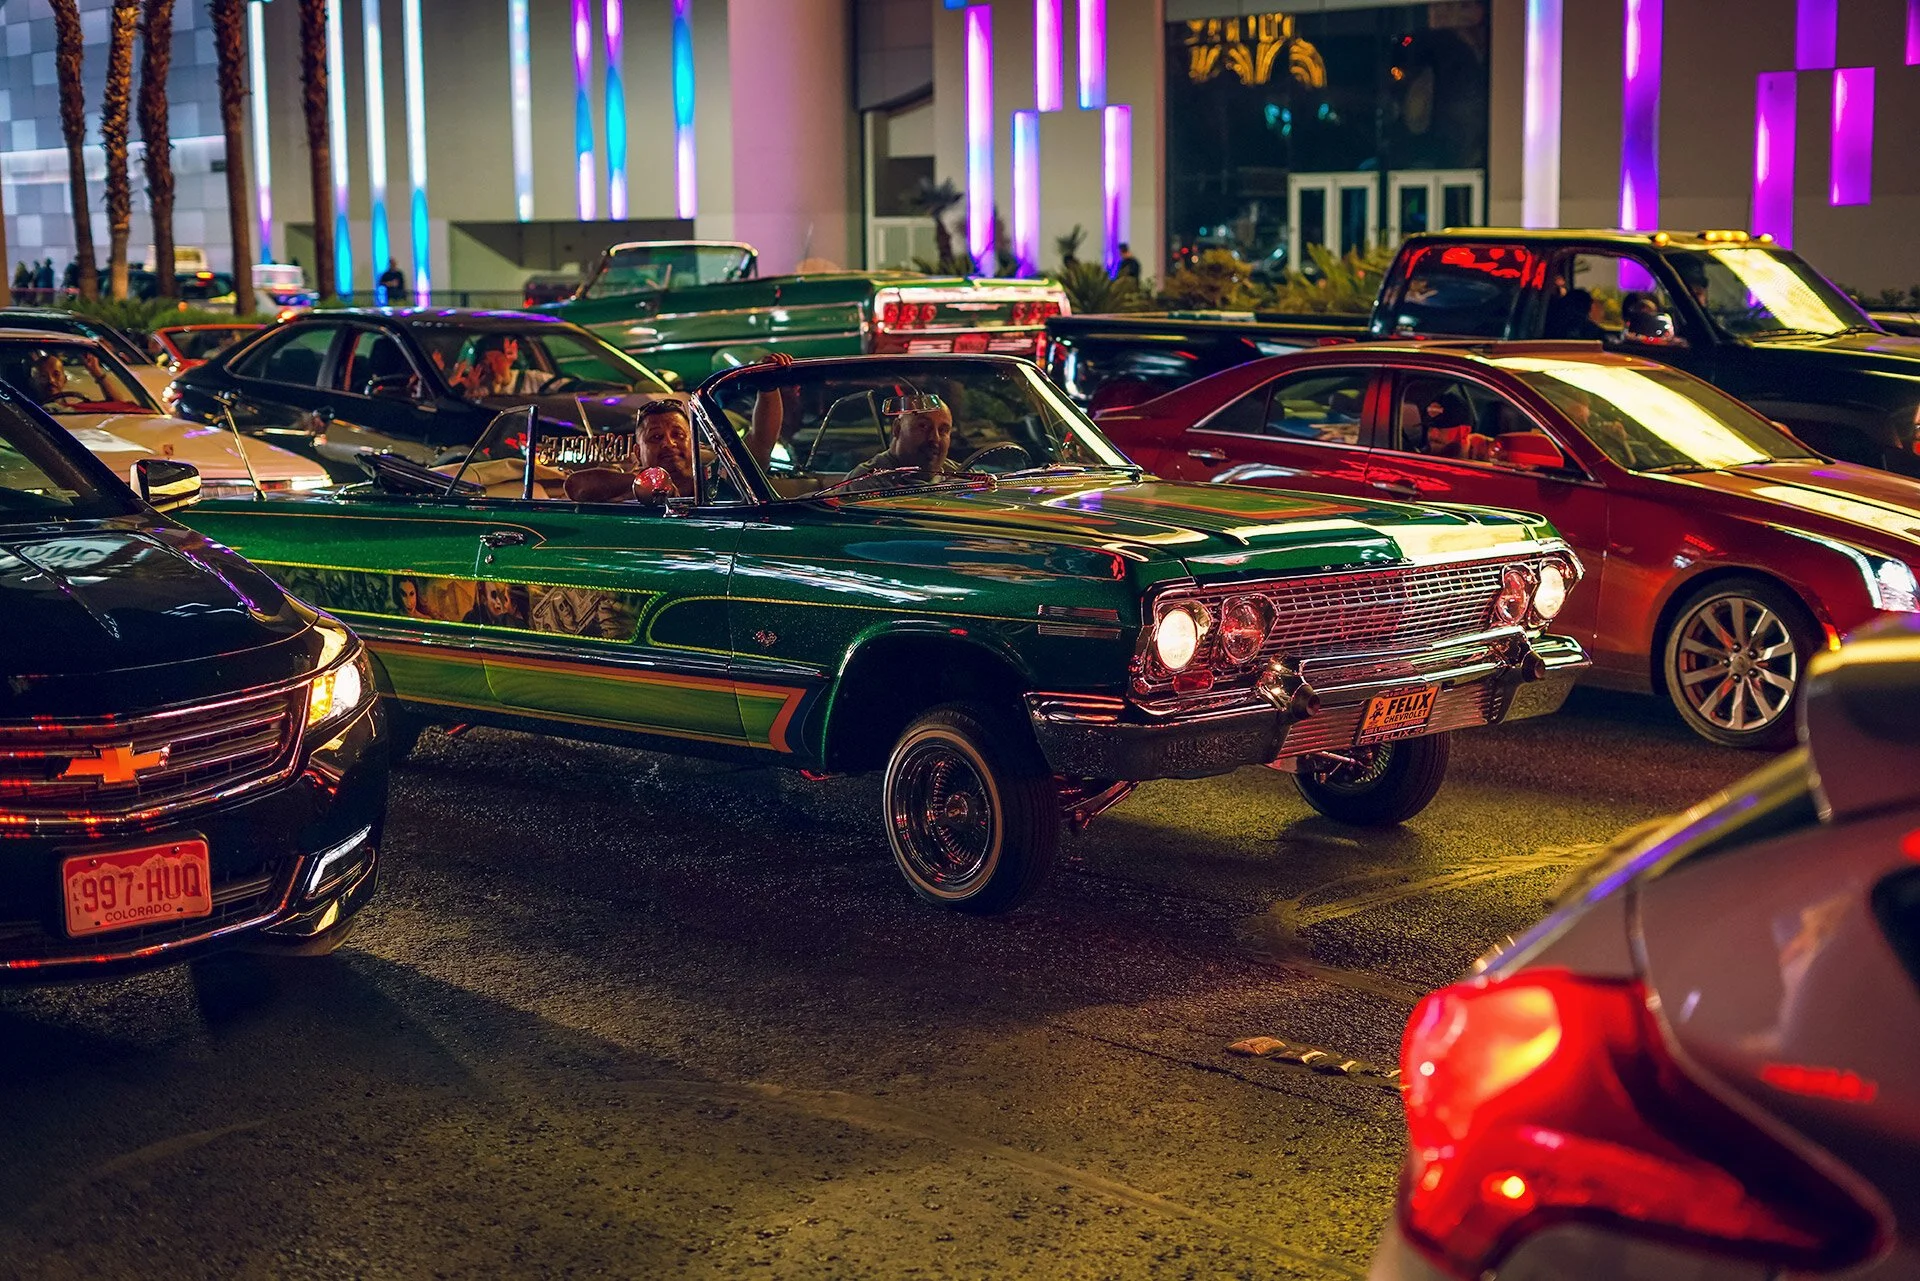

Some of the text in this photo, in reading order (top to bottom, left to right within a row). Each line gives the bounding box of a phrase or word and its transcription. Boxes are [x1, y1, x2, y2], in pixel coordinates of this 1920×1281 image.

[1387, 693, 1432, 715] FELIX
[1384, 709, 1427, 723] CHEVROLET
[1375, 730, 1410, 741] FELIX
[105, 903, 172, 922] COLORADO
